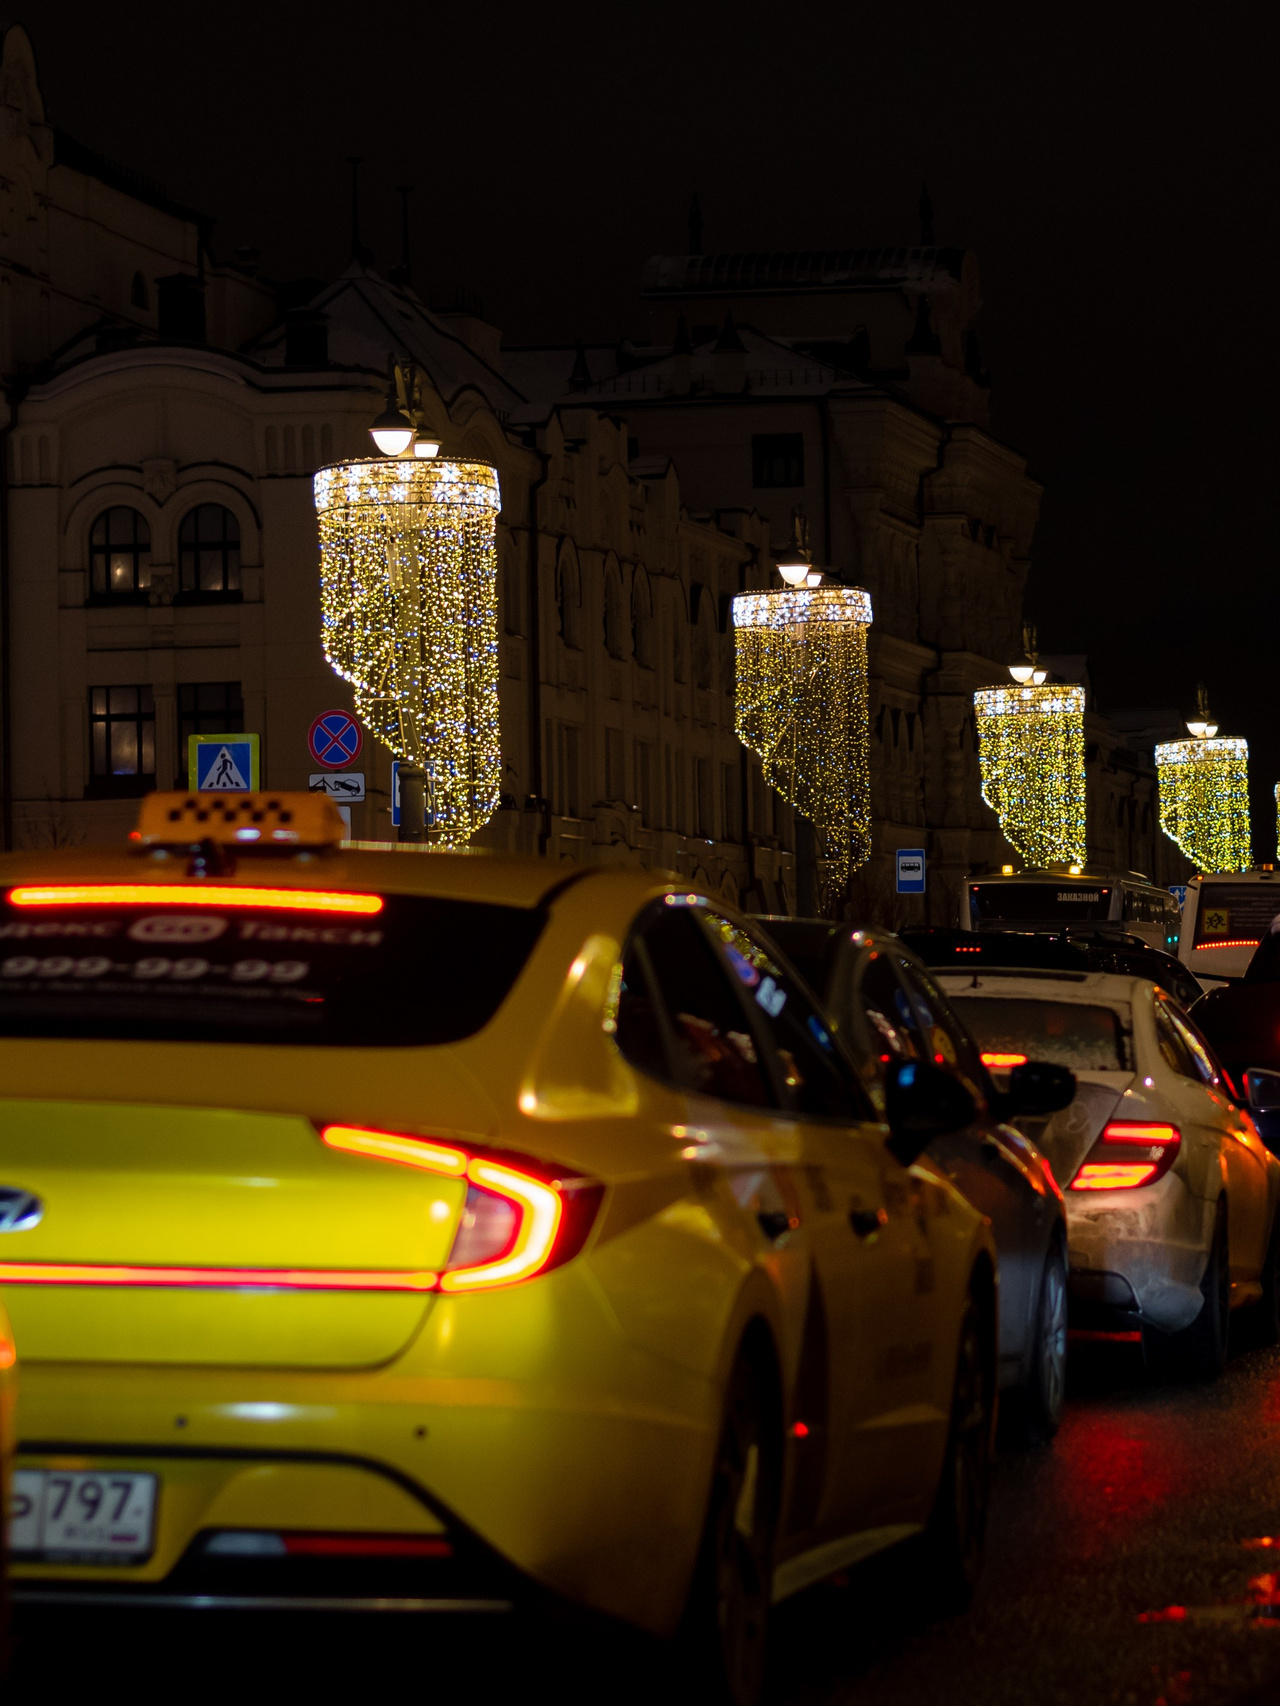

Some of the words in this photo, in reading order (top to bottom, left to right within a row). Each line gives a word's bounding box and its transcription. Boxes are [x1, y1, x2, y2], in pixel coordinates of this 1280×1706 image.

[1057, 892, 1099, 902] ЗАКАЗНОЙ
[2, 956, 310, 982] 999-99-99
[52, 1479, 133, 1522] 797
